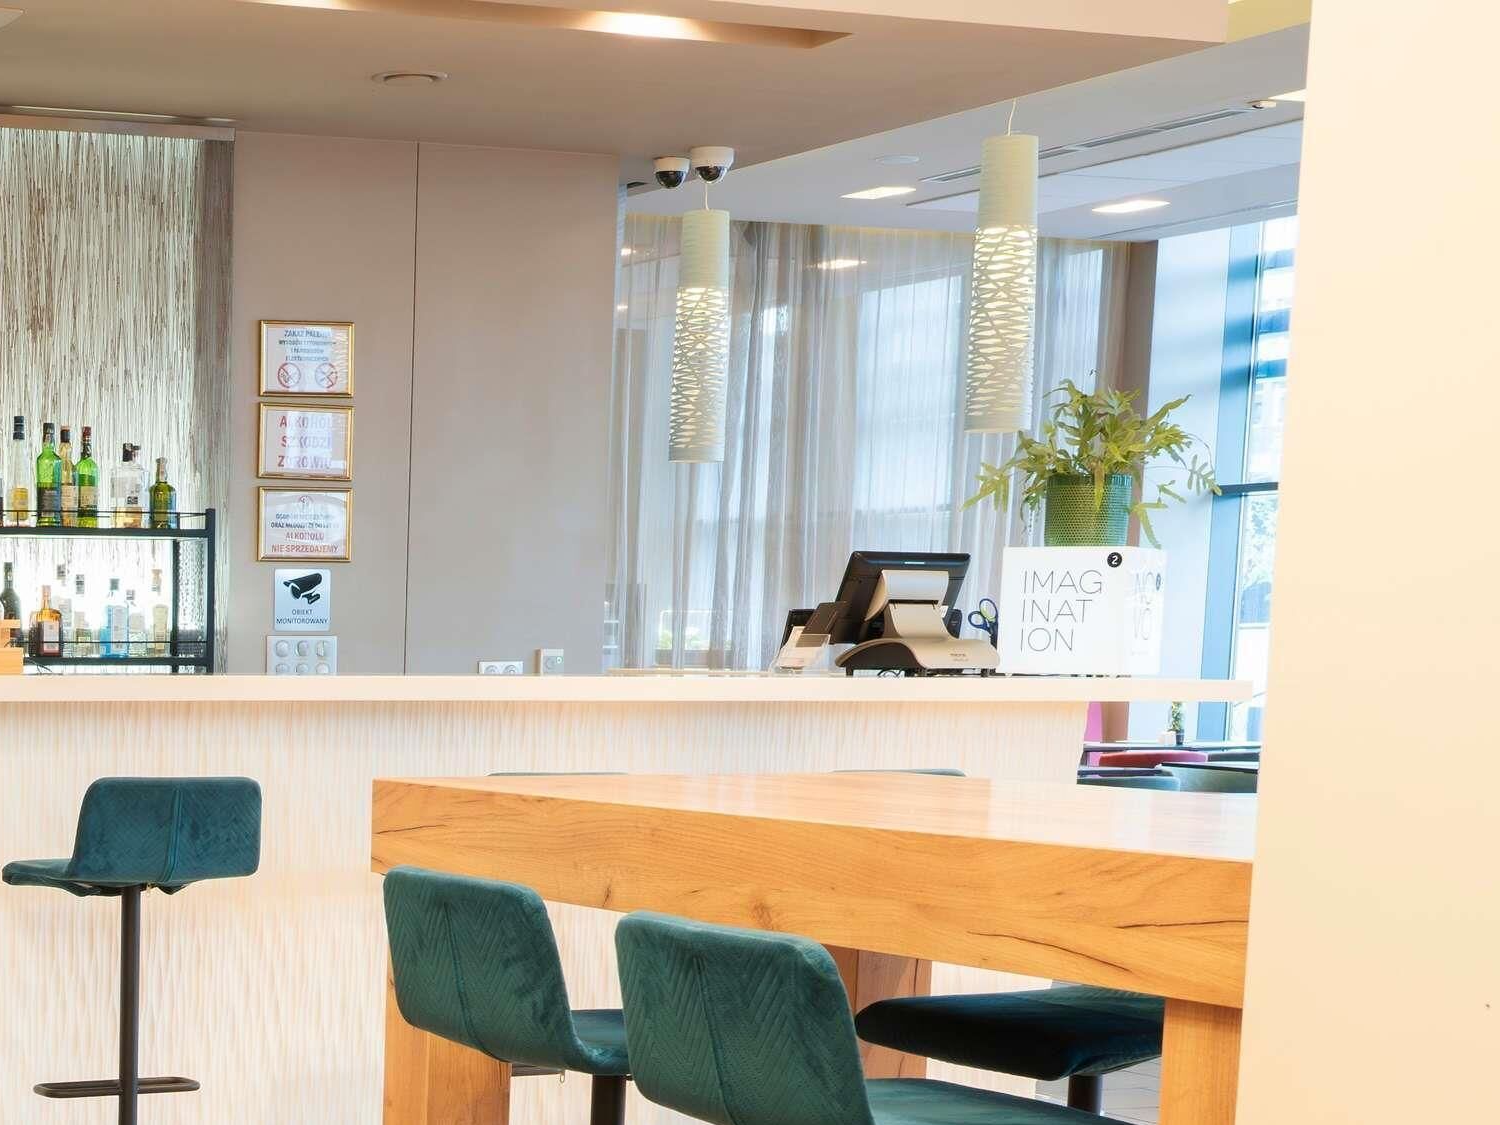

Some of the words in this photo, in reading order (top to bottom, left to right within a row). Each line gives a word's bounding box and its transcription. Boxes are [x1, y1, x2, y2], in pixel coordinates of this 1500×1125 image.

[279, 415, 333, 430] AKOHOL
[1023, 569, 1103, 595] IMAG
[275, 617, 328, 625] MONITOROWANY
[1021, 598, 1093, 623] INAT
[1020, 627, 1074, 652] ION
